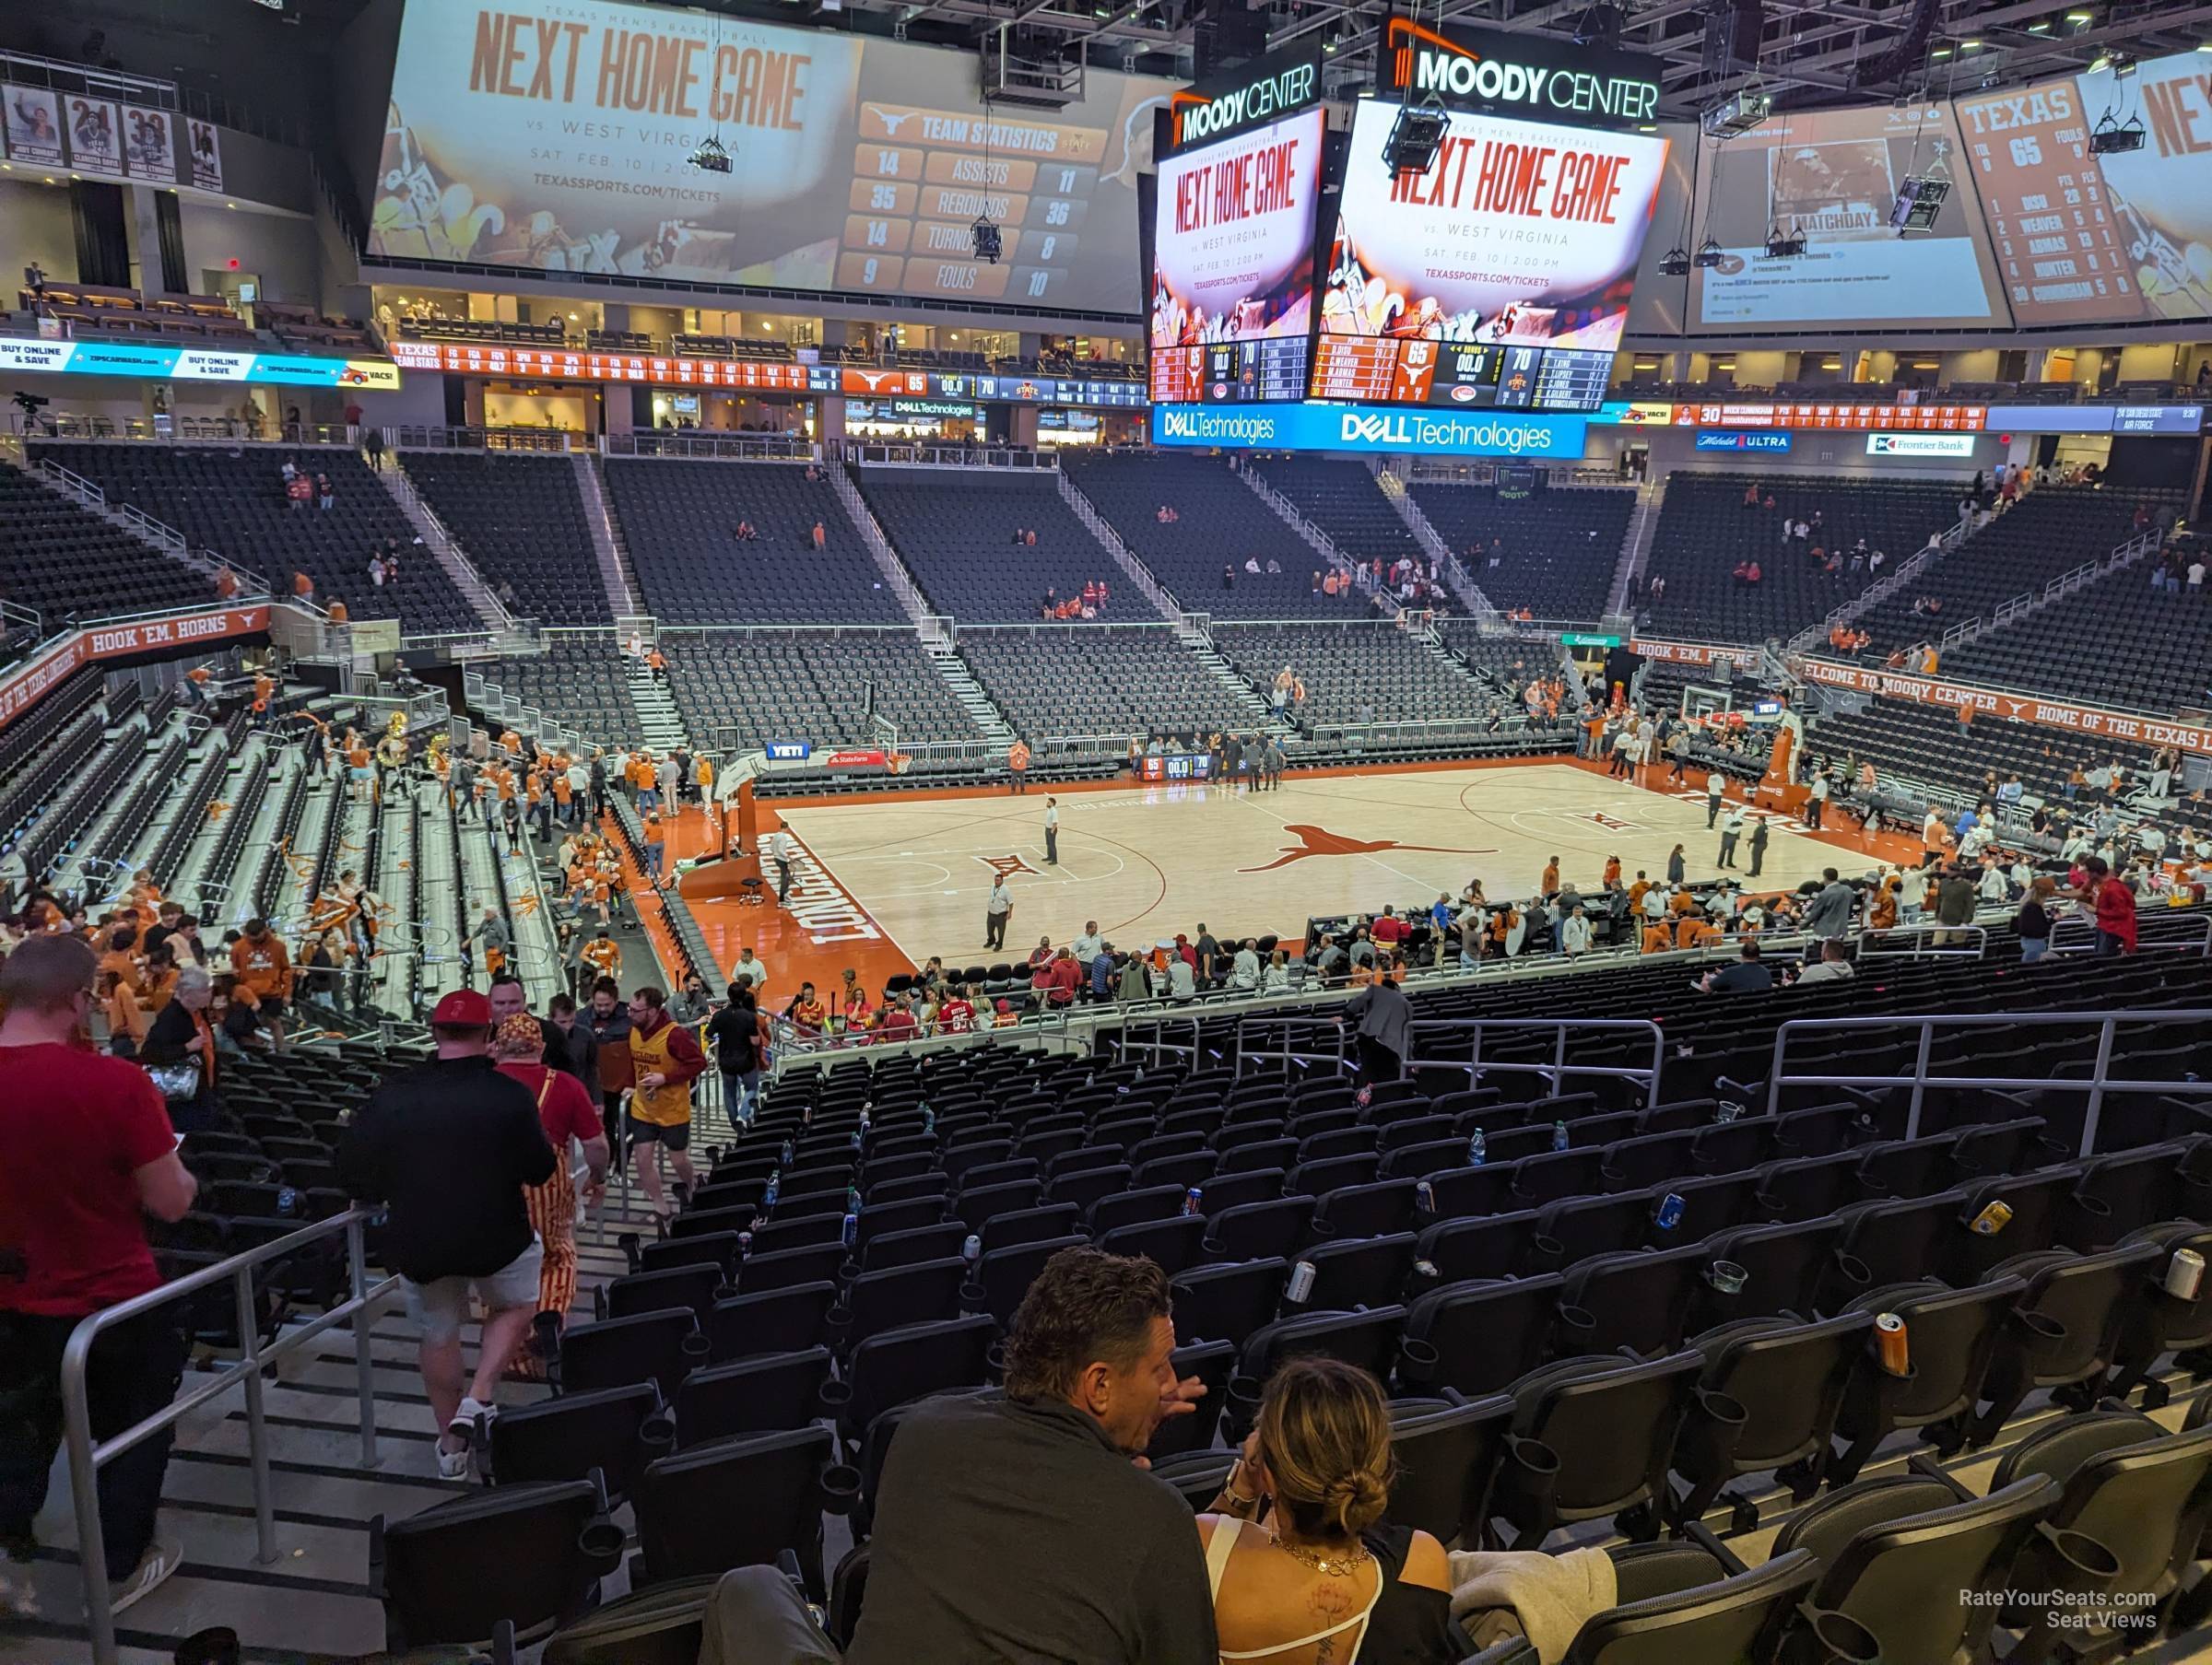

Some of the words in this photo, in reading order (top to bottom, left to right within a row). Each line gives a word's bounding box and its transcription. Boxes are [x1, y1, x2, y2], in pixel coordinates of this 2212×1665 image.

[469, 10, 589, 103] NEXT
[596, 28, 707, 118] HOME
[709, 44, 812, 131] GAME
[1417, 51, 1548, 104] MOODY
[1548, 70, 1658, 120] CENTER
[1182, 89, 1247, 142] MOODY
[1247, 63, 1312, 119] CENTER
[1965, 88, 2071, 134] TEXAS
[562, 120, 627, 140] WEST
[923, 116, 968, 141] TEAM
[971, 123, 1059, 153] STATISTICS
[2055, 128, 2084, 144] FOULS
[2009, 135, 2042, 167] 65
[877, 150, 900, 176] 14
[952, 158, 1010, 185] ASSISTS
[1058, 170, 1077, 193] 11
[2057, 175, 2073, 187] PTS
[2081, 171, 2096, 183] FLS
[534, 172, 721, 203] TEXASSPORTS.COM/TICKETS
[1176, 166, 1211, 236] NEXT
[1214, 152, 1253, 227] HOME
[1254, 139, 1299, 215] GAME
[1473, 140, 1556, 217] HOME
[1550, 150, 1630, 226] GAME
[870, 184, 897, 210] 35
[936, 191, 1009, 219] REBOUNDS
[1045, 201, 1070, 227] 36
[1798, 213, 1872, 230] MATCHDAY
[2019, 215, 2064, 234] WEAVER
[2074, 210, 2084, 226] 5
[2095, 207, 2104, 223] 4
[867, 221, 887, 246] 14
[1041, 236, 1056, 260] 8
[1203, 236, 1225, 251] WEST
[1228, 229, 1267, 245] VIRGINIA
[1447, 223, 1490, 240] WEST
[1499, 228, 1569, 246] VIRGINIA
[2003, 240, 2012, 256] 3
[2078, 231, 2093, 248] 13
[1487, 253, 1500, 264] 10
[1513, 255, 1540, 267] 2:00
[1544, 259, 1560, 268] PM
[863, 258, 877, 285] 9
[935, 264, 977, 290] FOULS
[1029, 272, 1049, 297] 10
[1194, 272, 1260, 290] TEXASSPORTS.COM/TICKETS
[1425, 267, 1550, 287] TEXASSPORTS.COM/TICKETS
[2012, 286, 2030, 302] 30
[1, 344, 21, 354] BUY
[24, 346, 61, 356] ONLINE
[397, 344, 436, 357] TEXAS
[1190, 346, 1200, 367] 65
[1244, 343, 1253, 364] 70
[1407, 342, 1429, 364] 65
[25, 357, 51, 365] SAVE
[188, 356, 206, 364] BUY
[208, 358, 240, 367] ONLINE
[394, 356, 415, 368] TEAM
[415, 357, 440, 369] STATS
[469, 360, 480, 370] 54
[1214, 353, 1230, 371] 00.0
[1456, 354, 1484, 373] 00.0
[1512, 348, 1532, 370] 70
[208, 367, 229, 375] SAVE
[370, 371, 394, 380] VACS!
[681, 372, 690, 381] 24
[810, 369, 820, 378] TOL
[810, 381, 828, 390] FOULS
[909, 376, 923, 391] 65
[941, 380, 963, 393] 00.0
[982, 380, 994, 394] 70
[1016, 387, 1039, 395] STATE
[1057, 393, 1073, 402] FOULS
[1077, 394, 1084, 404] 10
[895, 402, 921, 413] DELL
[920, 404, 973, 416] Technologies
[1700, 407, 1720, 423] 30
[2183, 409, 2196, 418] 9:30
[1164, 412, 1197, 438] DELL
[1197, 412, 1275, 445] Technologies
[1341, 413, 1412, 444] DELL
[1411, 416, 1552, 454] Technologies
[2124, 420, 2135, 429] AIR
[2135, 420, 2154, 430] FORCE
[1747, 436, 1787, 447] ULTRA
[1898, 439, 1936, 450] Frontier
[1939, 440, 1964, 451] Bank
[92, 628, 137, 653] HOOK
[177, 616, 227, 639] HORNS
[1637, 643, 1672, 658] HOOK
[15, 682, 29, 708] THE
[28, 667, 46, 696] TEXAS
[46, 647, 76, 684] LONGHORNS
[1804, 663, 1855, 686] ELCOME
[1860, 673, 1876, 687] TO
[1882, 677, 1932, 698] MOODY
[1936, 686, 1998, 710] CENTER
[1759, 703, 1779, 713] YETI
[2036, 705, 2079, 726] HOME
[2082, 713, 2102, 730] OF
[2106, 717, 2139, 737] THE
[2144, 724, 2198, 748] TEXAS
[772, 745, 803, 756] YETI
[1147, 758, 1159, 770] 65
[1168, 761, 1187, 774] 00.0
[1198, 756, 1207, 768] 70
[952, 1013, 968, 1030] 85
